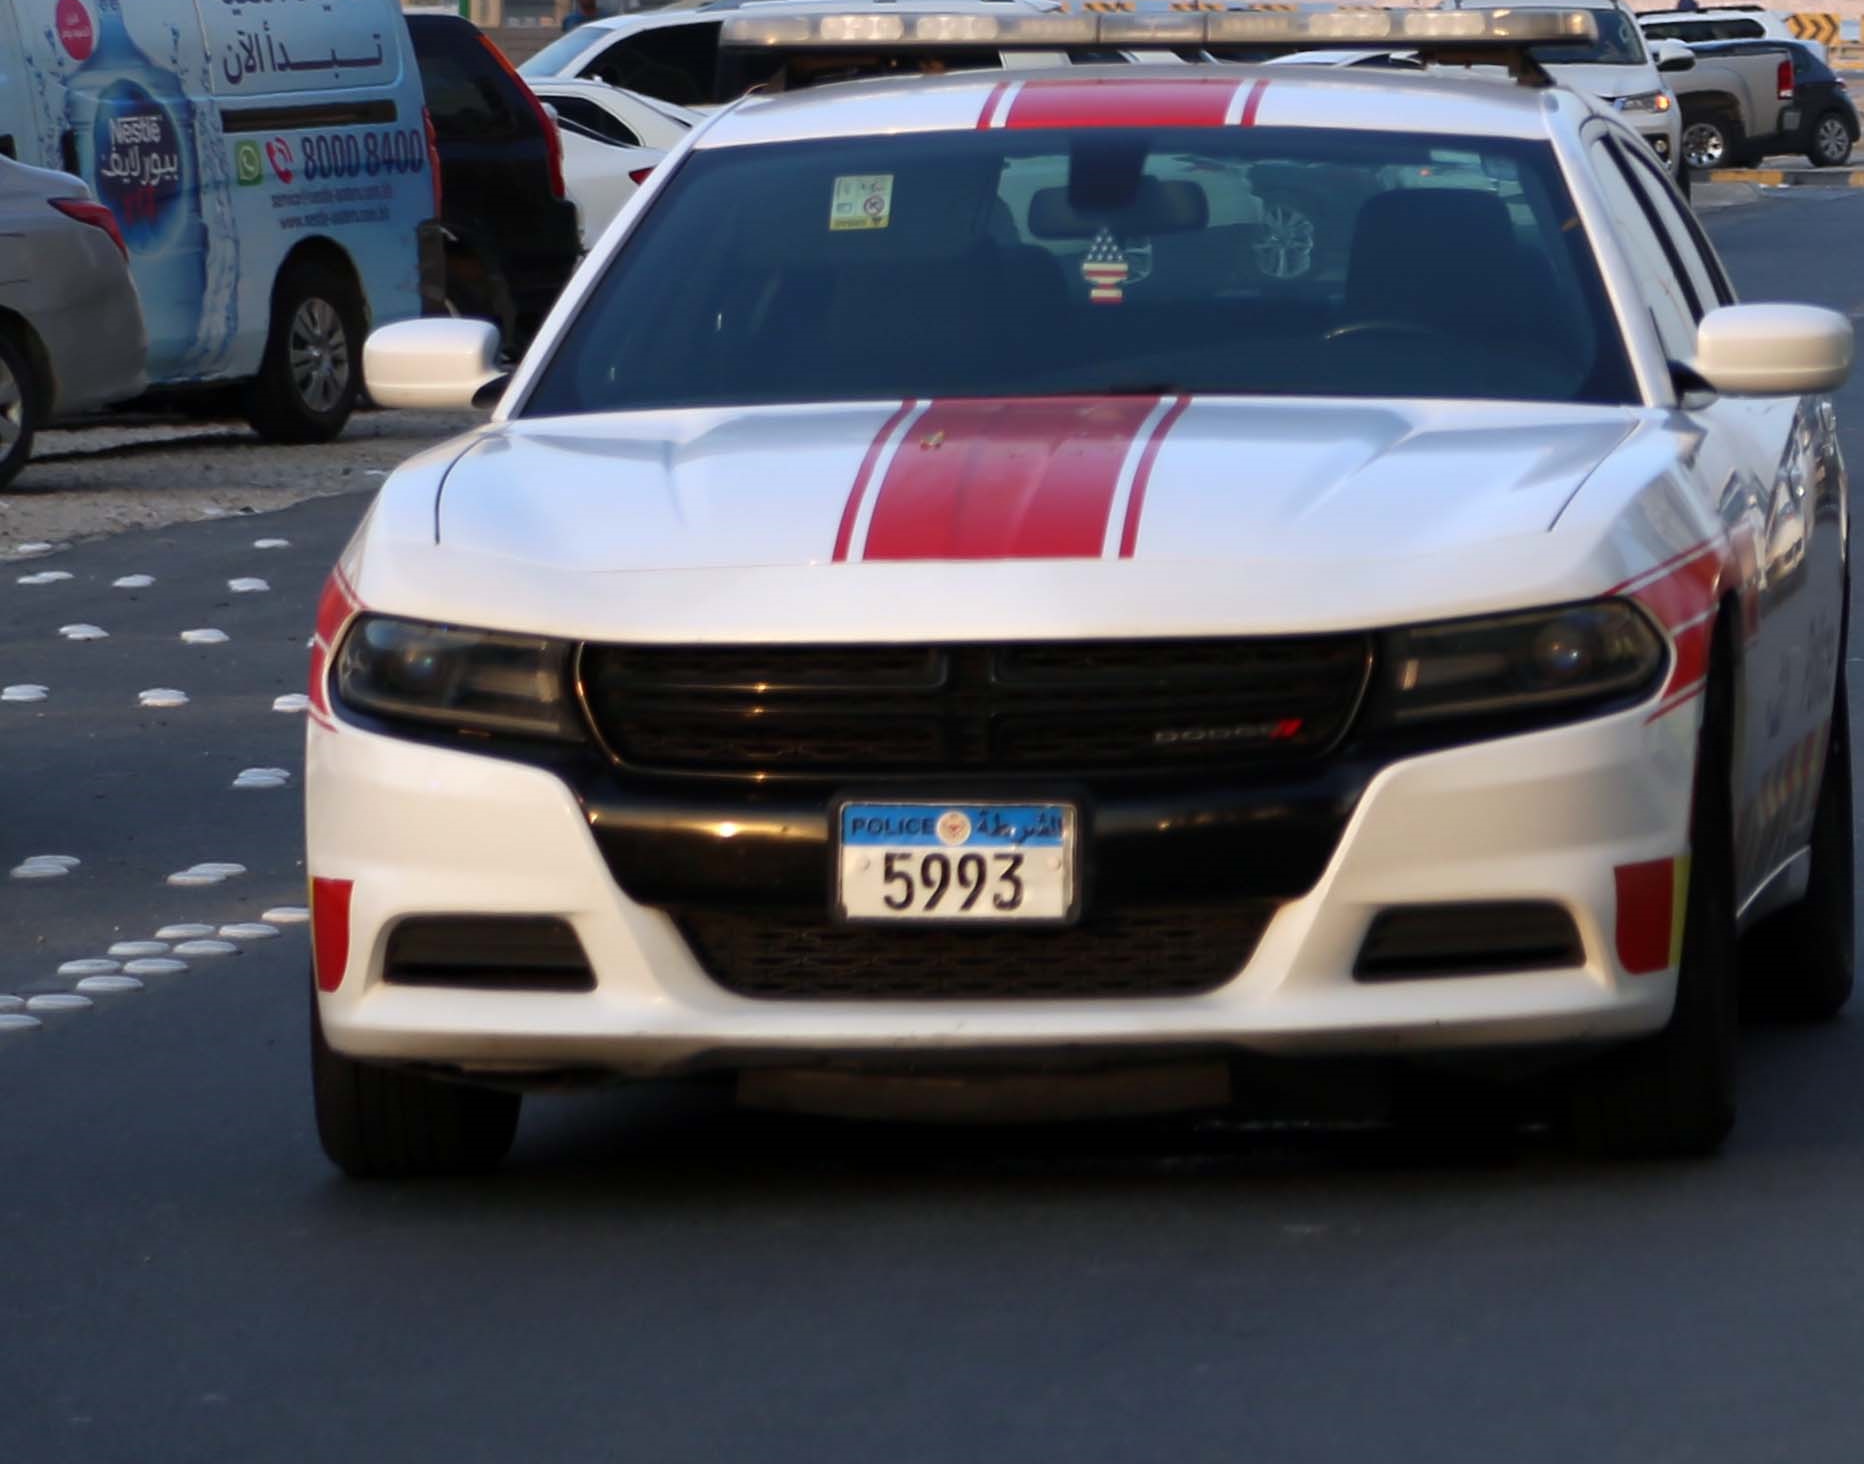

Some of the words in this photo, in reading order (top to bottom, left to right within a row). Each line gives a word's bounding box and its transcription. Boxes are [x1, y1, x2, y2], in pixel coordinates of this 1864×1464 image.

[302, 134, 360, 181] 8000
[365, 128, 425, 178] 8400
[852, 816, 935, 836] POLICE
[882, 851, 1025, 912] 5993
